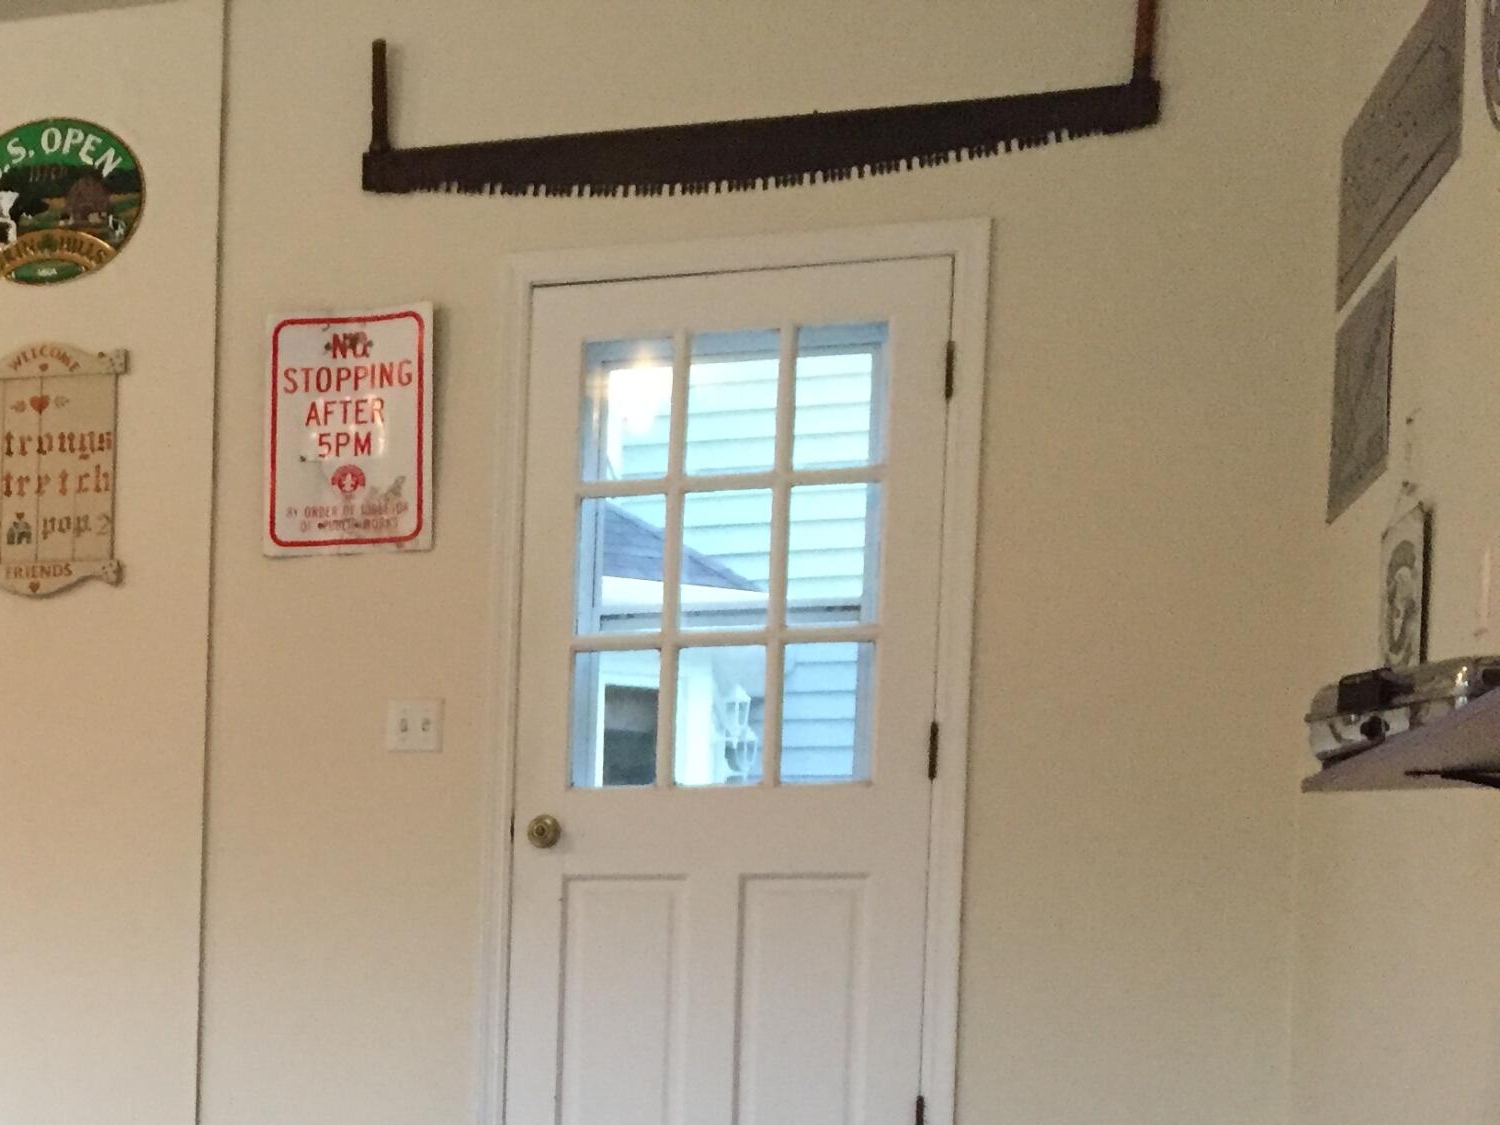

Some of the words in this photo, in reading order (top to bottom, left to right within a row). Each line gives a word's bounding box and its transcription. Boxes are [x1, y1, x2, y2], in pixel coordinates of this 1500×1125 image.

[41, 127, 124, 178] OPEN
[9, 345, 81, 373] WELCOME
[283, 360, 413, 395] STOPPING
[305, 398, 385, 427] AFTER
[318, 432, 372, 458] 5PM
[6, 563, 73, 580] FRIENDS
